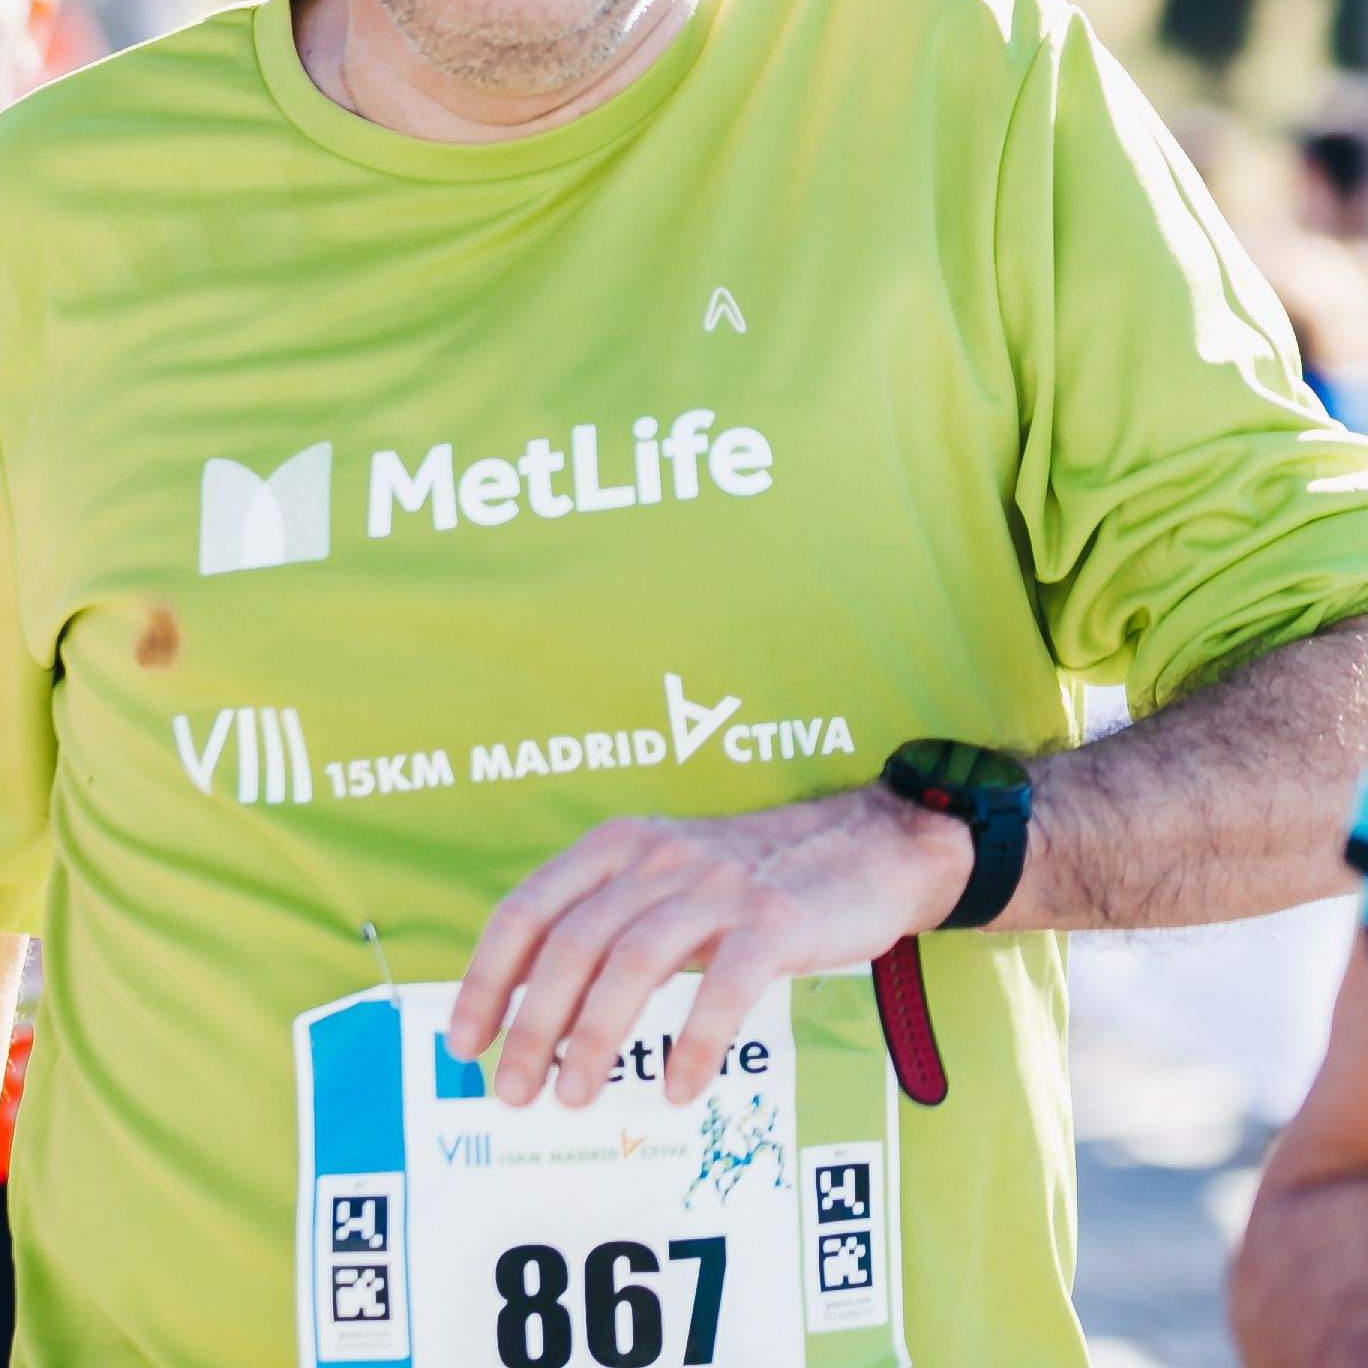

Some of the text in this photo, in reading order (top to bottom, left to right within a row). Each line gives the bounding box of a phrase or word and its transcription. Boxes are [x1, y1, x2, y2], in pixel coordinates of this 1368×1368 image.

[366, 408, 774, 539] MetLife
[172, 706, 313, 806] VIII
[324, 750, 455, 800] 15KM
[470, 729, 666, 784] MADRID
[495, 1236, 728, 1368] 867
